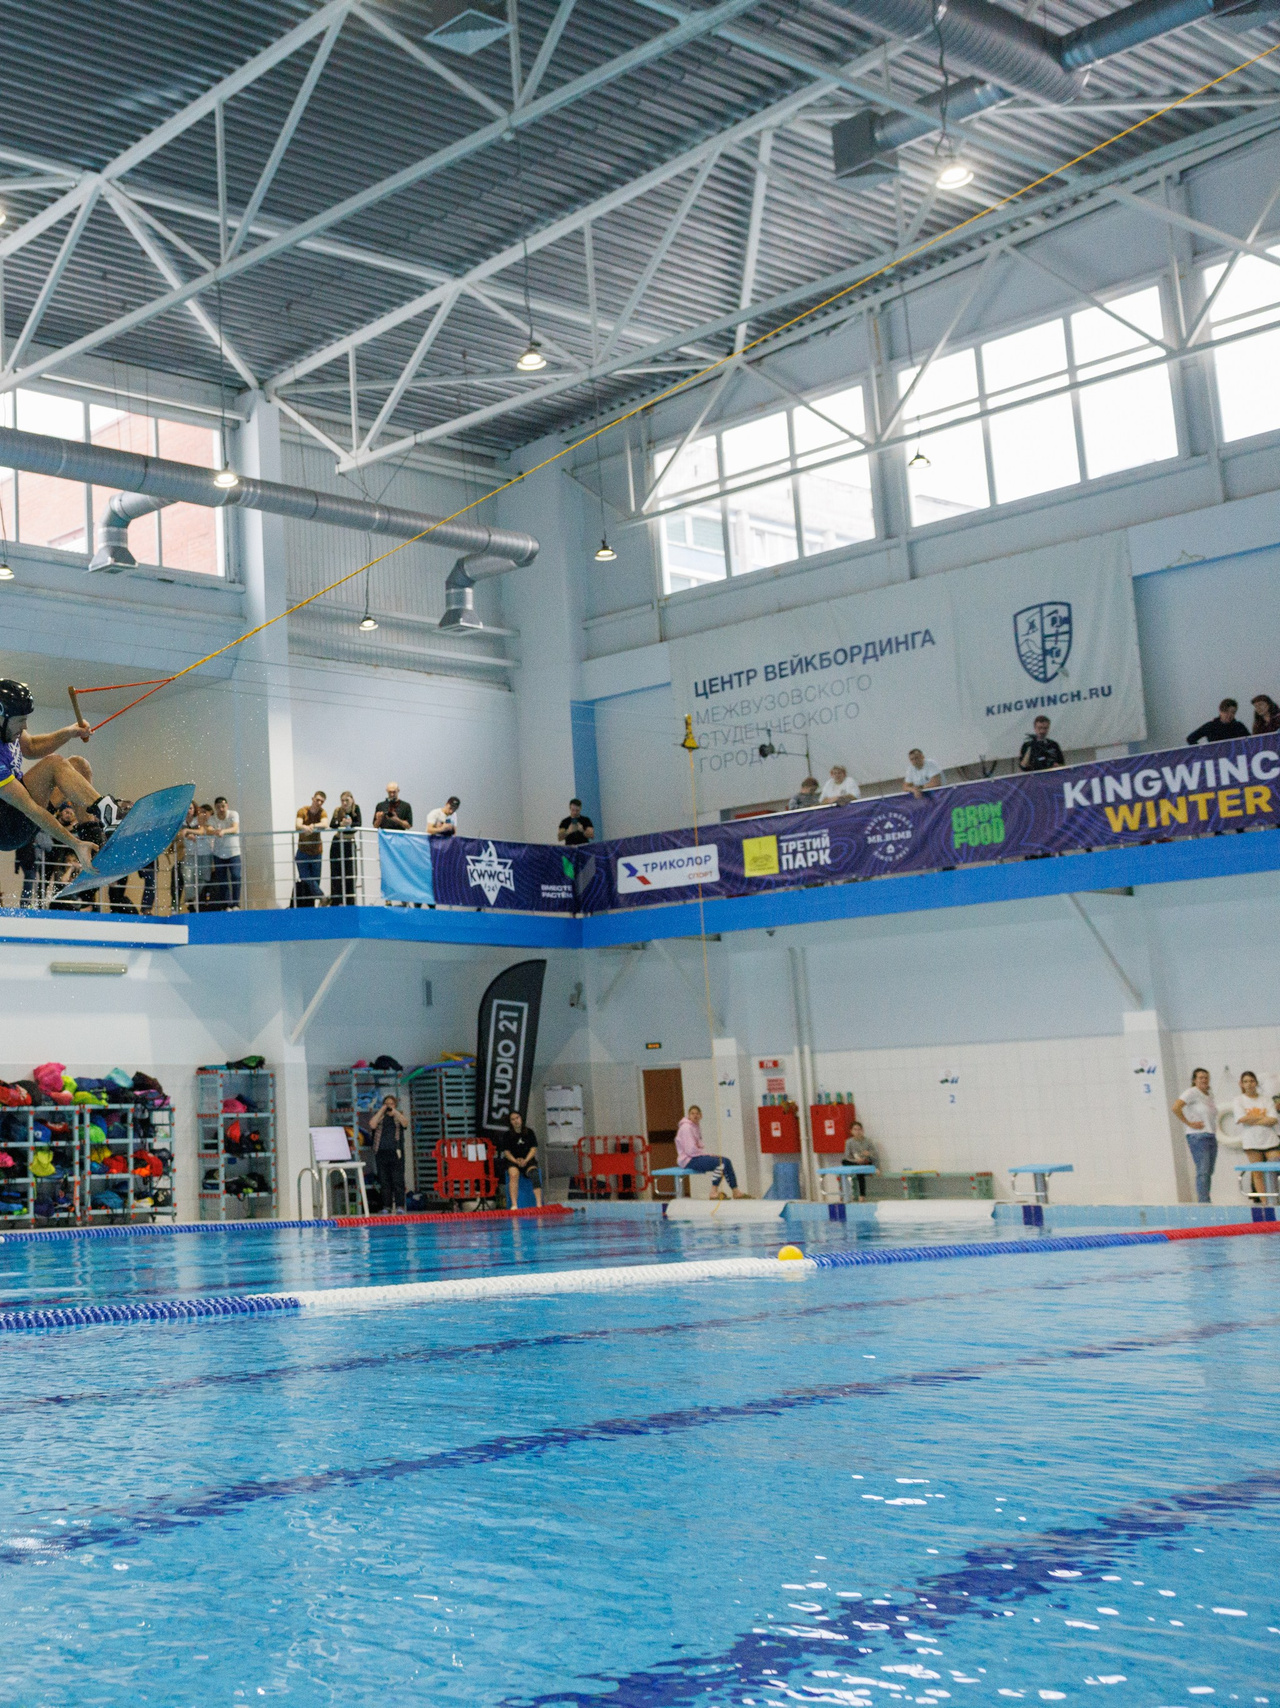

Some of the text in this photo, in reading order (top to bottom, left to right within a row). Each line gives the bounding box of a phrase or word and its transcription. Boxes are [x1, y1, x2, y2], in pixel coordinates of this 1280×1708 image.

[694, 629, 936, 699] ЦЕНТР ВЕЙКБОРДИНГА
[696, 674, 872, 725] МЕЖВУЗОВСКОГО
[986, 685, 1112, 716] KINGWINCH.RU
[697, 702, 860, 750] СТУДЕНЧЕСКОГО
[699, 743, 788, 773] ГОРОДА
[1104, 785, 1274, 834] WINTER
[780, 833, 831, 853] ТРЕТИЙ
[953, 817, 1006, 849] FOOD
[643, 854, 712, 873] ТРИКОЛОР
[781, 848, 832, 871] ПАРК
[469, 868, 512, 888] KWWCH
[492, 1010, 519, 1120] STUDIO 21
[949, 1094, 956, 1104] 2
[1144, 1083, 1151, 1093] 3
